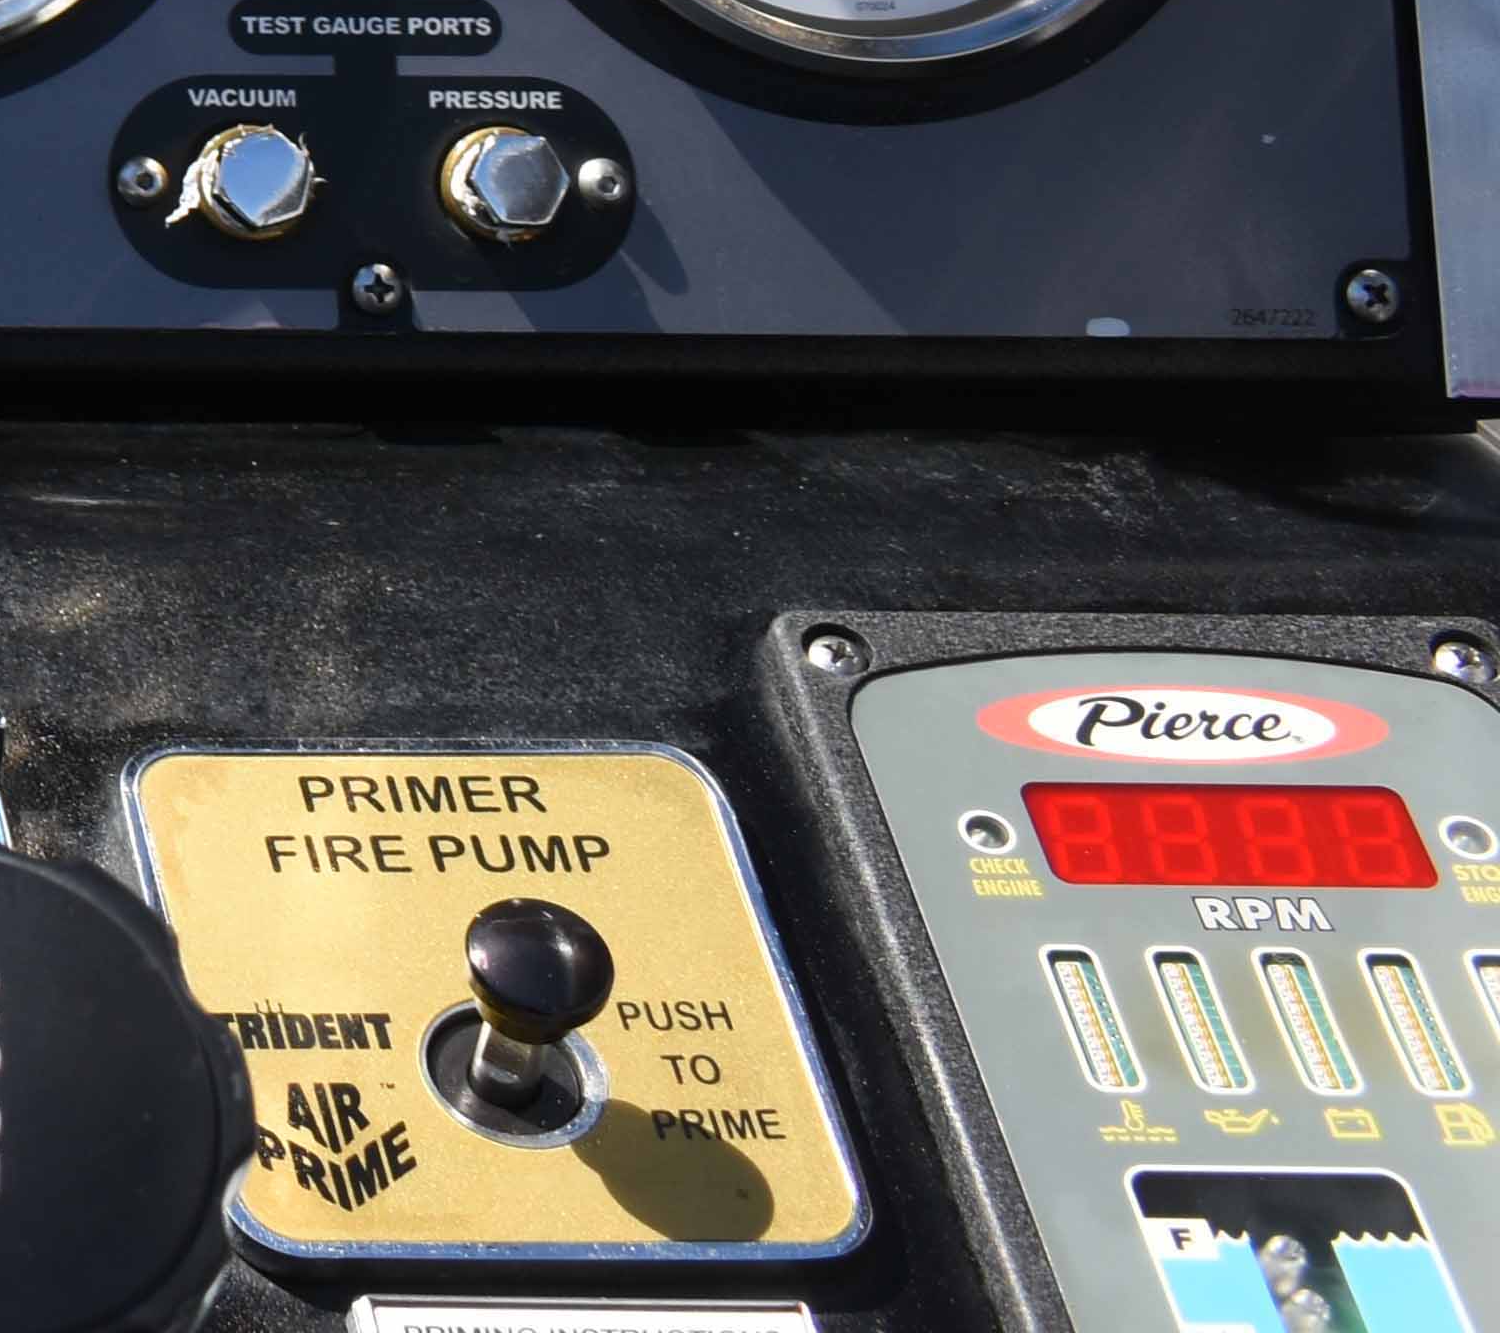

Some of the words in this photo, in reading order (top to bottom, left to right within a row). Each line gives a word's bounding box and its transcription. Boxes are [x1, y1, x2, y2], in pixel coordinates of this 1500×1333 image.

[242, 17, 305, 34] TEST
[313, 17, 402, 34] GAUGE
[408, 17, 491, 34] PORTS
[188, 89, 296, 107] VACUUM
[429, 91, 562, 109] PRESSURE
[1076, 692, 1298, 746] Pierce
[298, 776, 547, 813] PRIMER
[265, 835, 412, 873] FIRE
[428, 835, 610, 873] PUMP
[969, 858, 1030, 876] CHECK
[973, 879, 1045, 898] ENGINE
[1191, 895, 1336, 932] RPM
[617, 1001, 733, 1031] PUSH
[660, 1055, 721, 1085] TO
[285, 1081, 368, 1151] AIR
[650, 1109, 787, 1141] PRIME
[257, 1121, 417, 1211] PRIME
[1171, 1228, 1195, 1250] F
